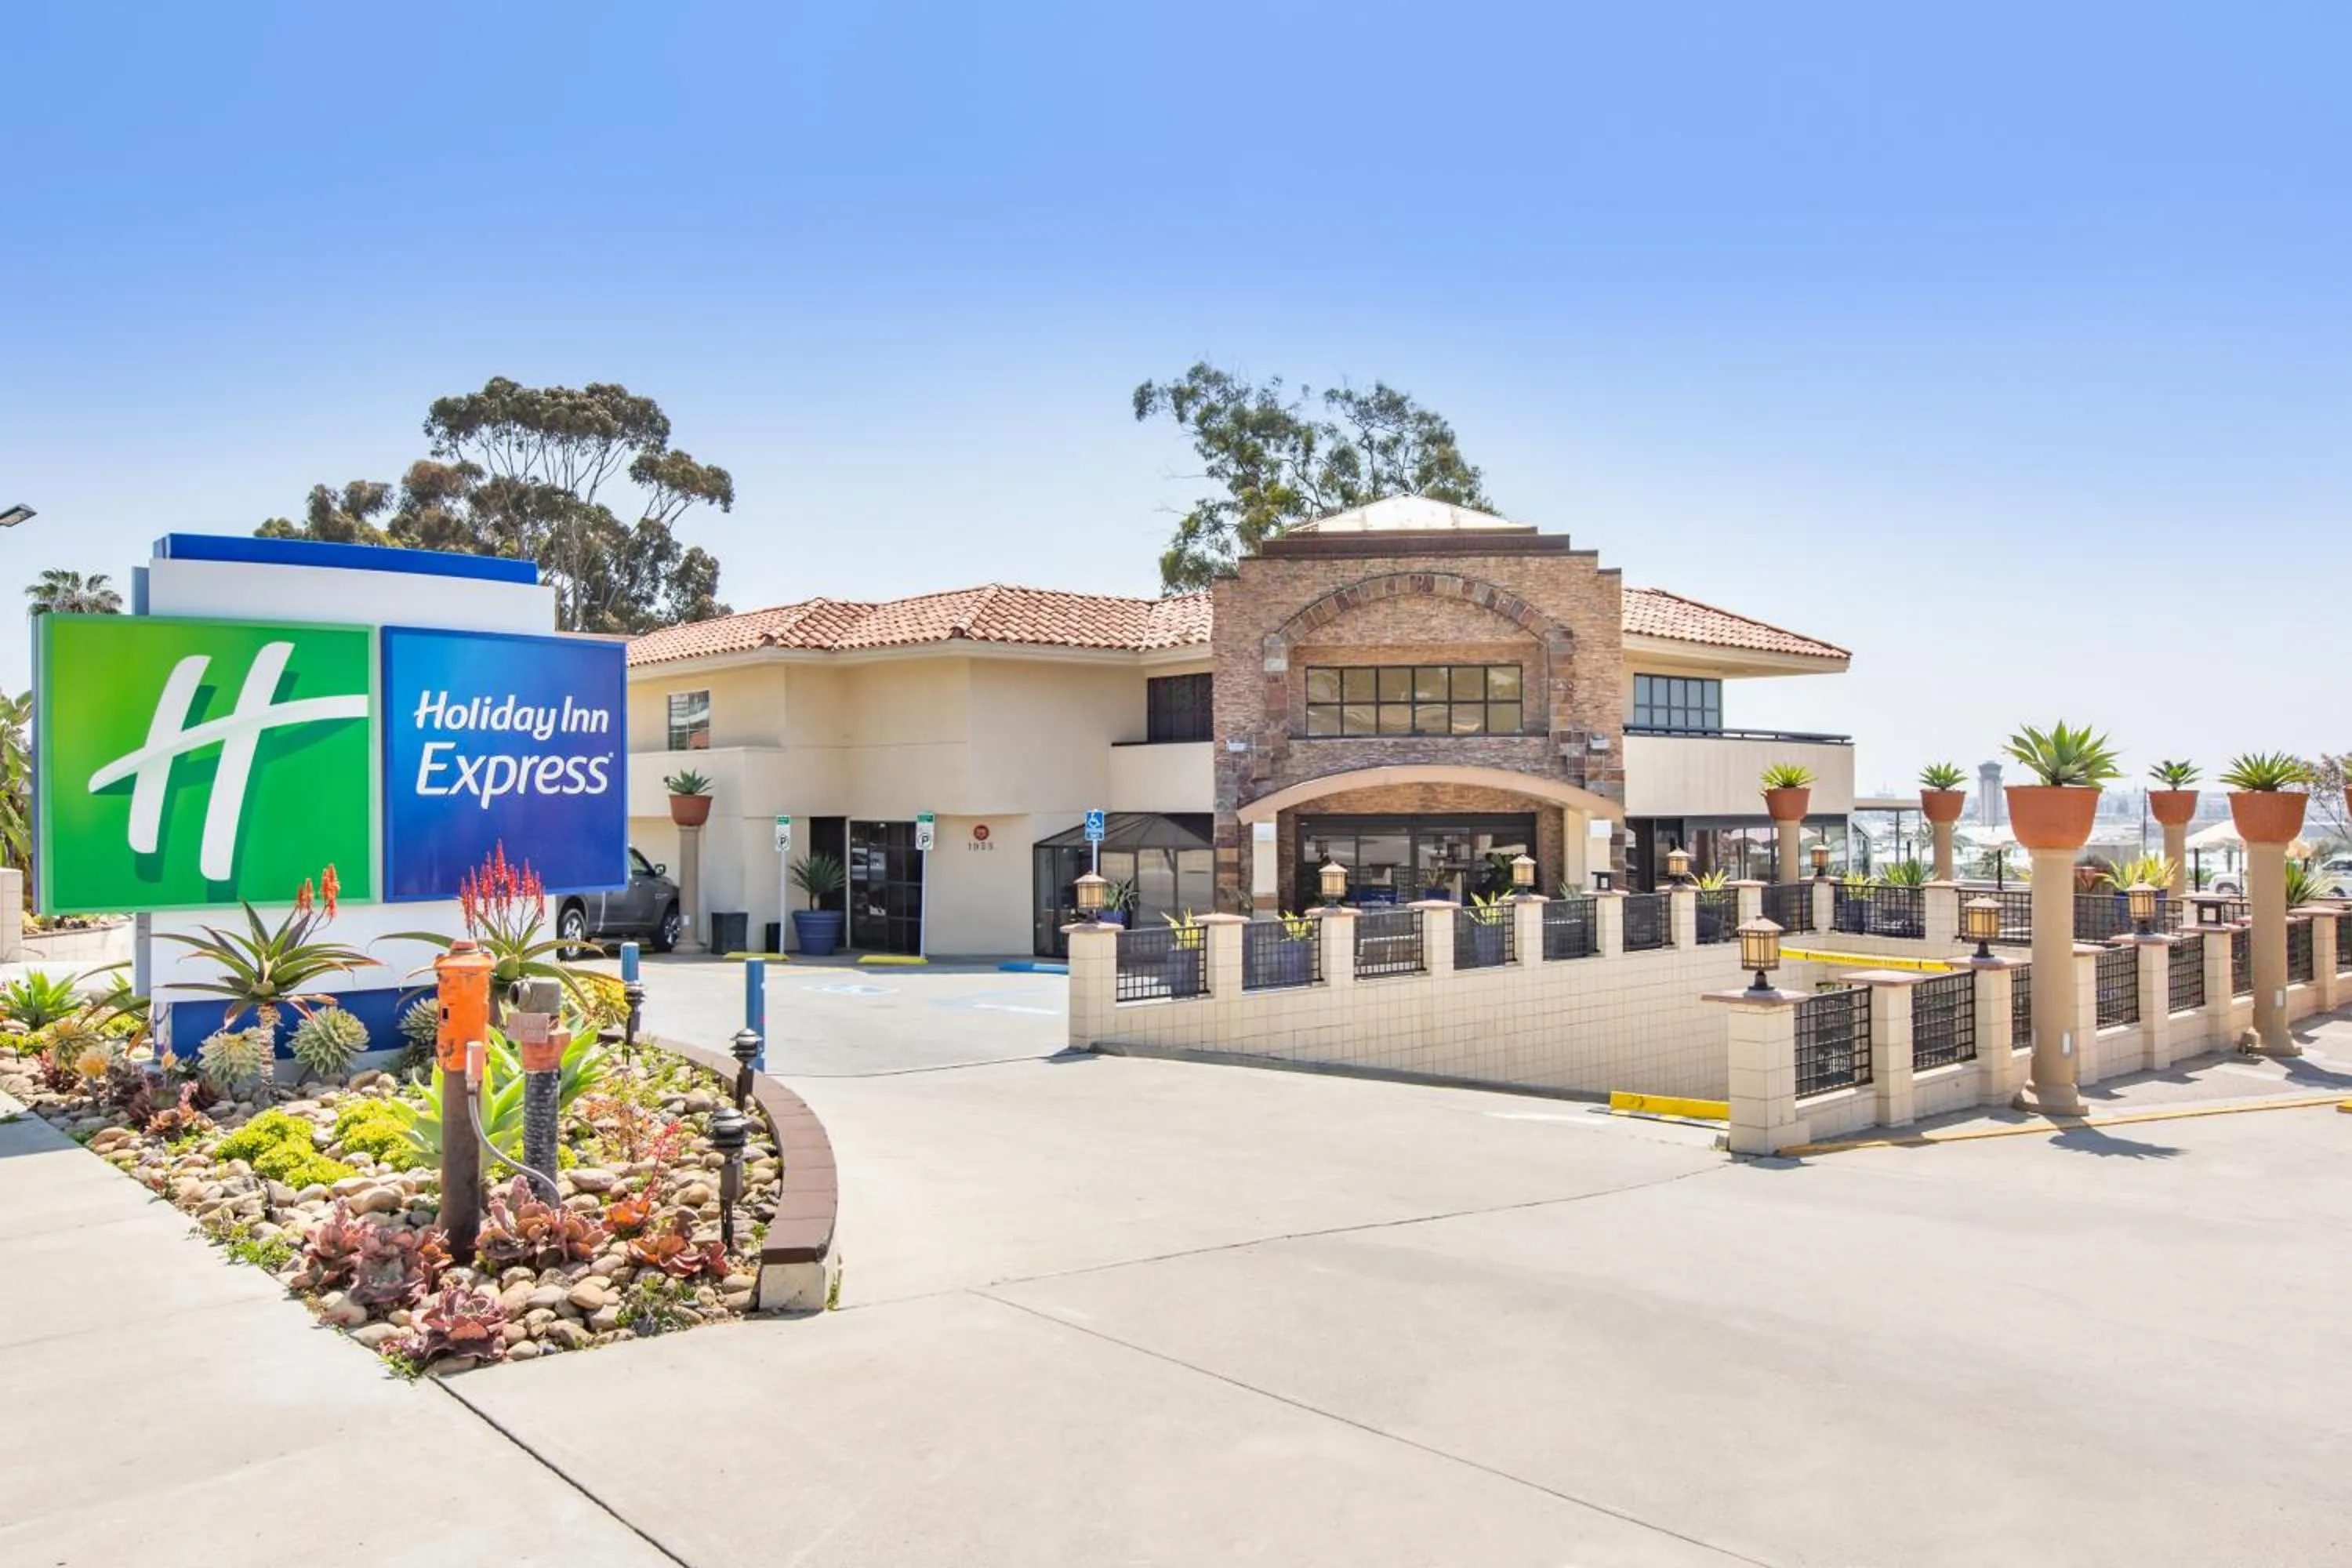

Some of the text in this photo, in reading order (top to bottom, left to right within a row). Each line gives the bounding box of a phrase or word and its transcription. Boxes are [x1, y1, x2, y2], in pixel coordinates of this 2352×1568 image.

[414, 690, 609, 741] Holiday Inn
[416, 742, 610, 810] Express
